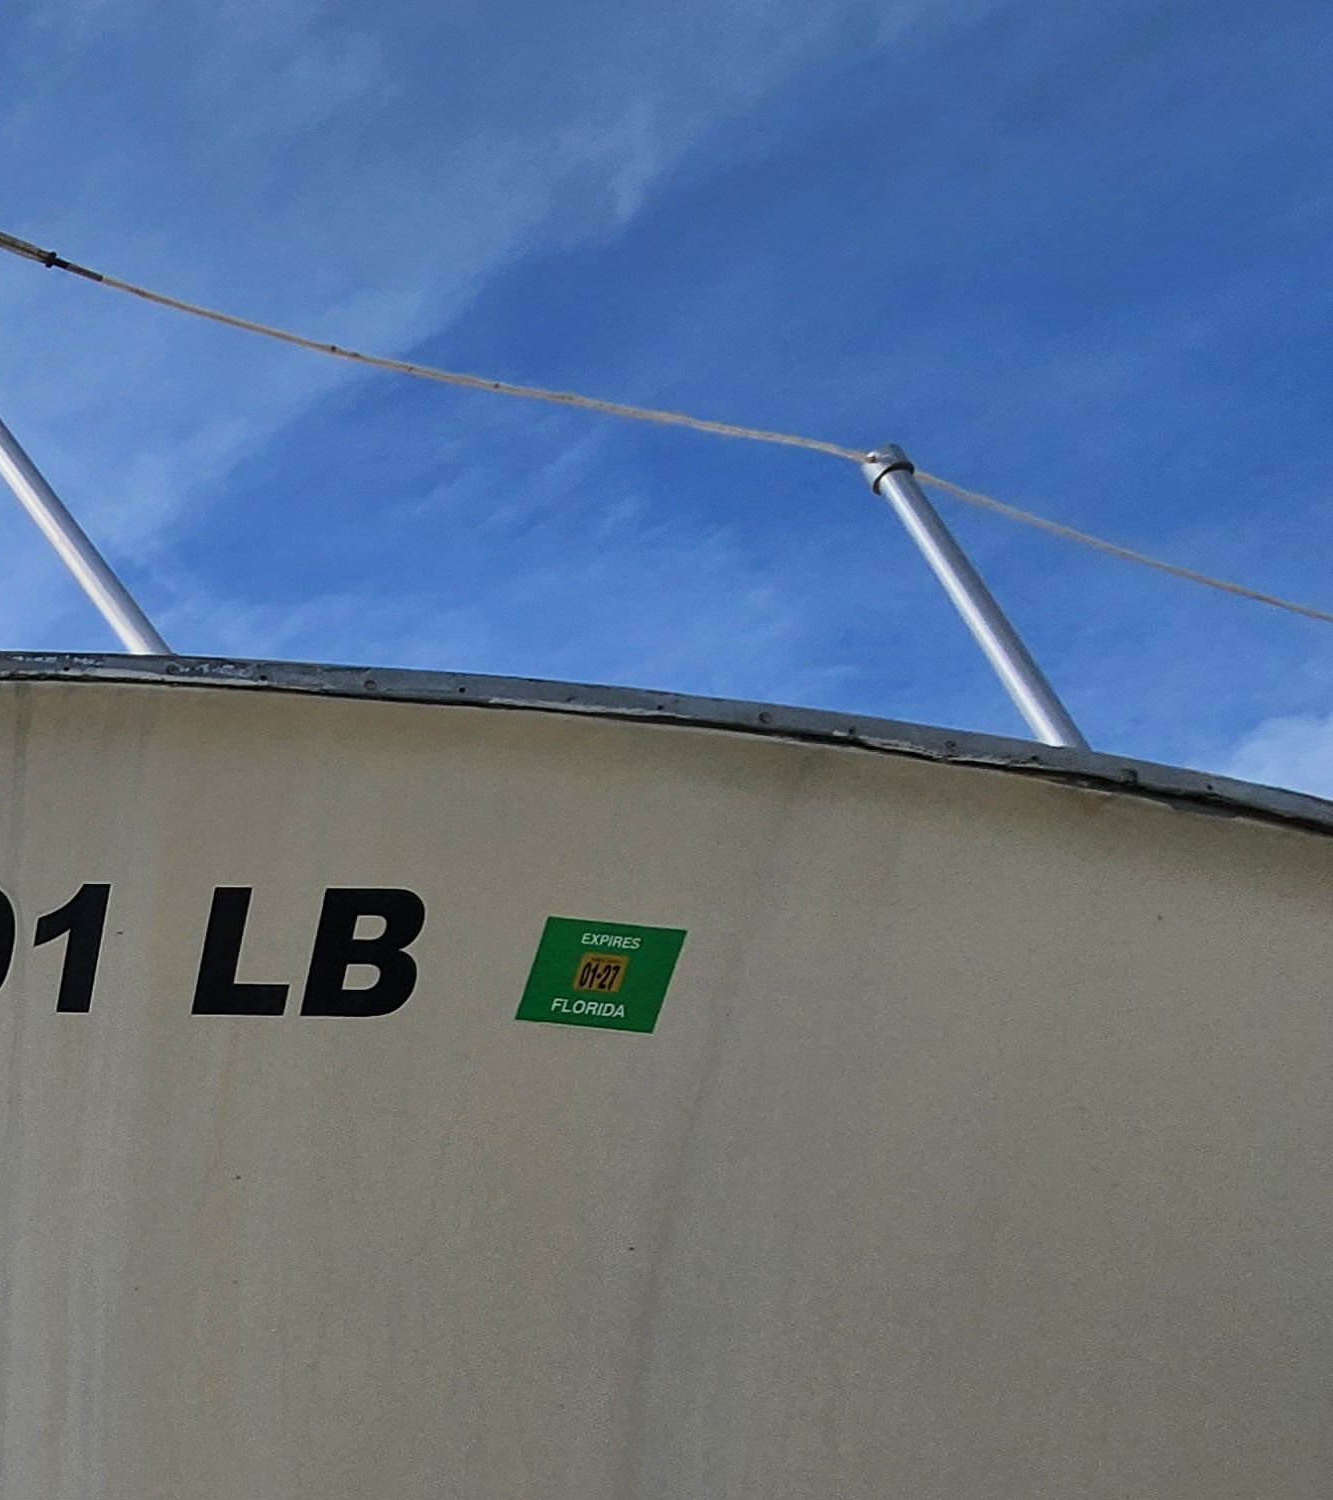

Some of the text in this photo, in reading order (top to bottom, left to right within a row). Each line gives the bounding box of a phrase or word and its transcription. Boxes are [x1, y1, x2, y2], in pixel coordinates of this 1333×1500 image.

[190, 885, 427, 1018] LB
[580, 932, 642, 950] EXPIRES
[550, 997, 626, 1019] FLORIDA
